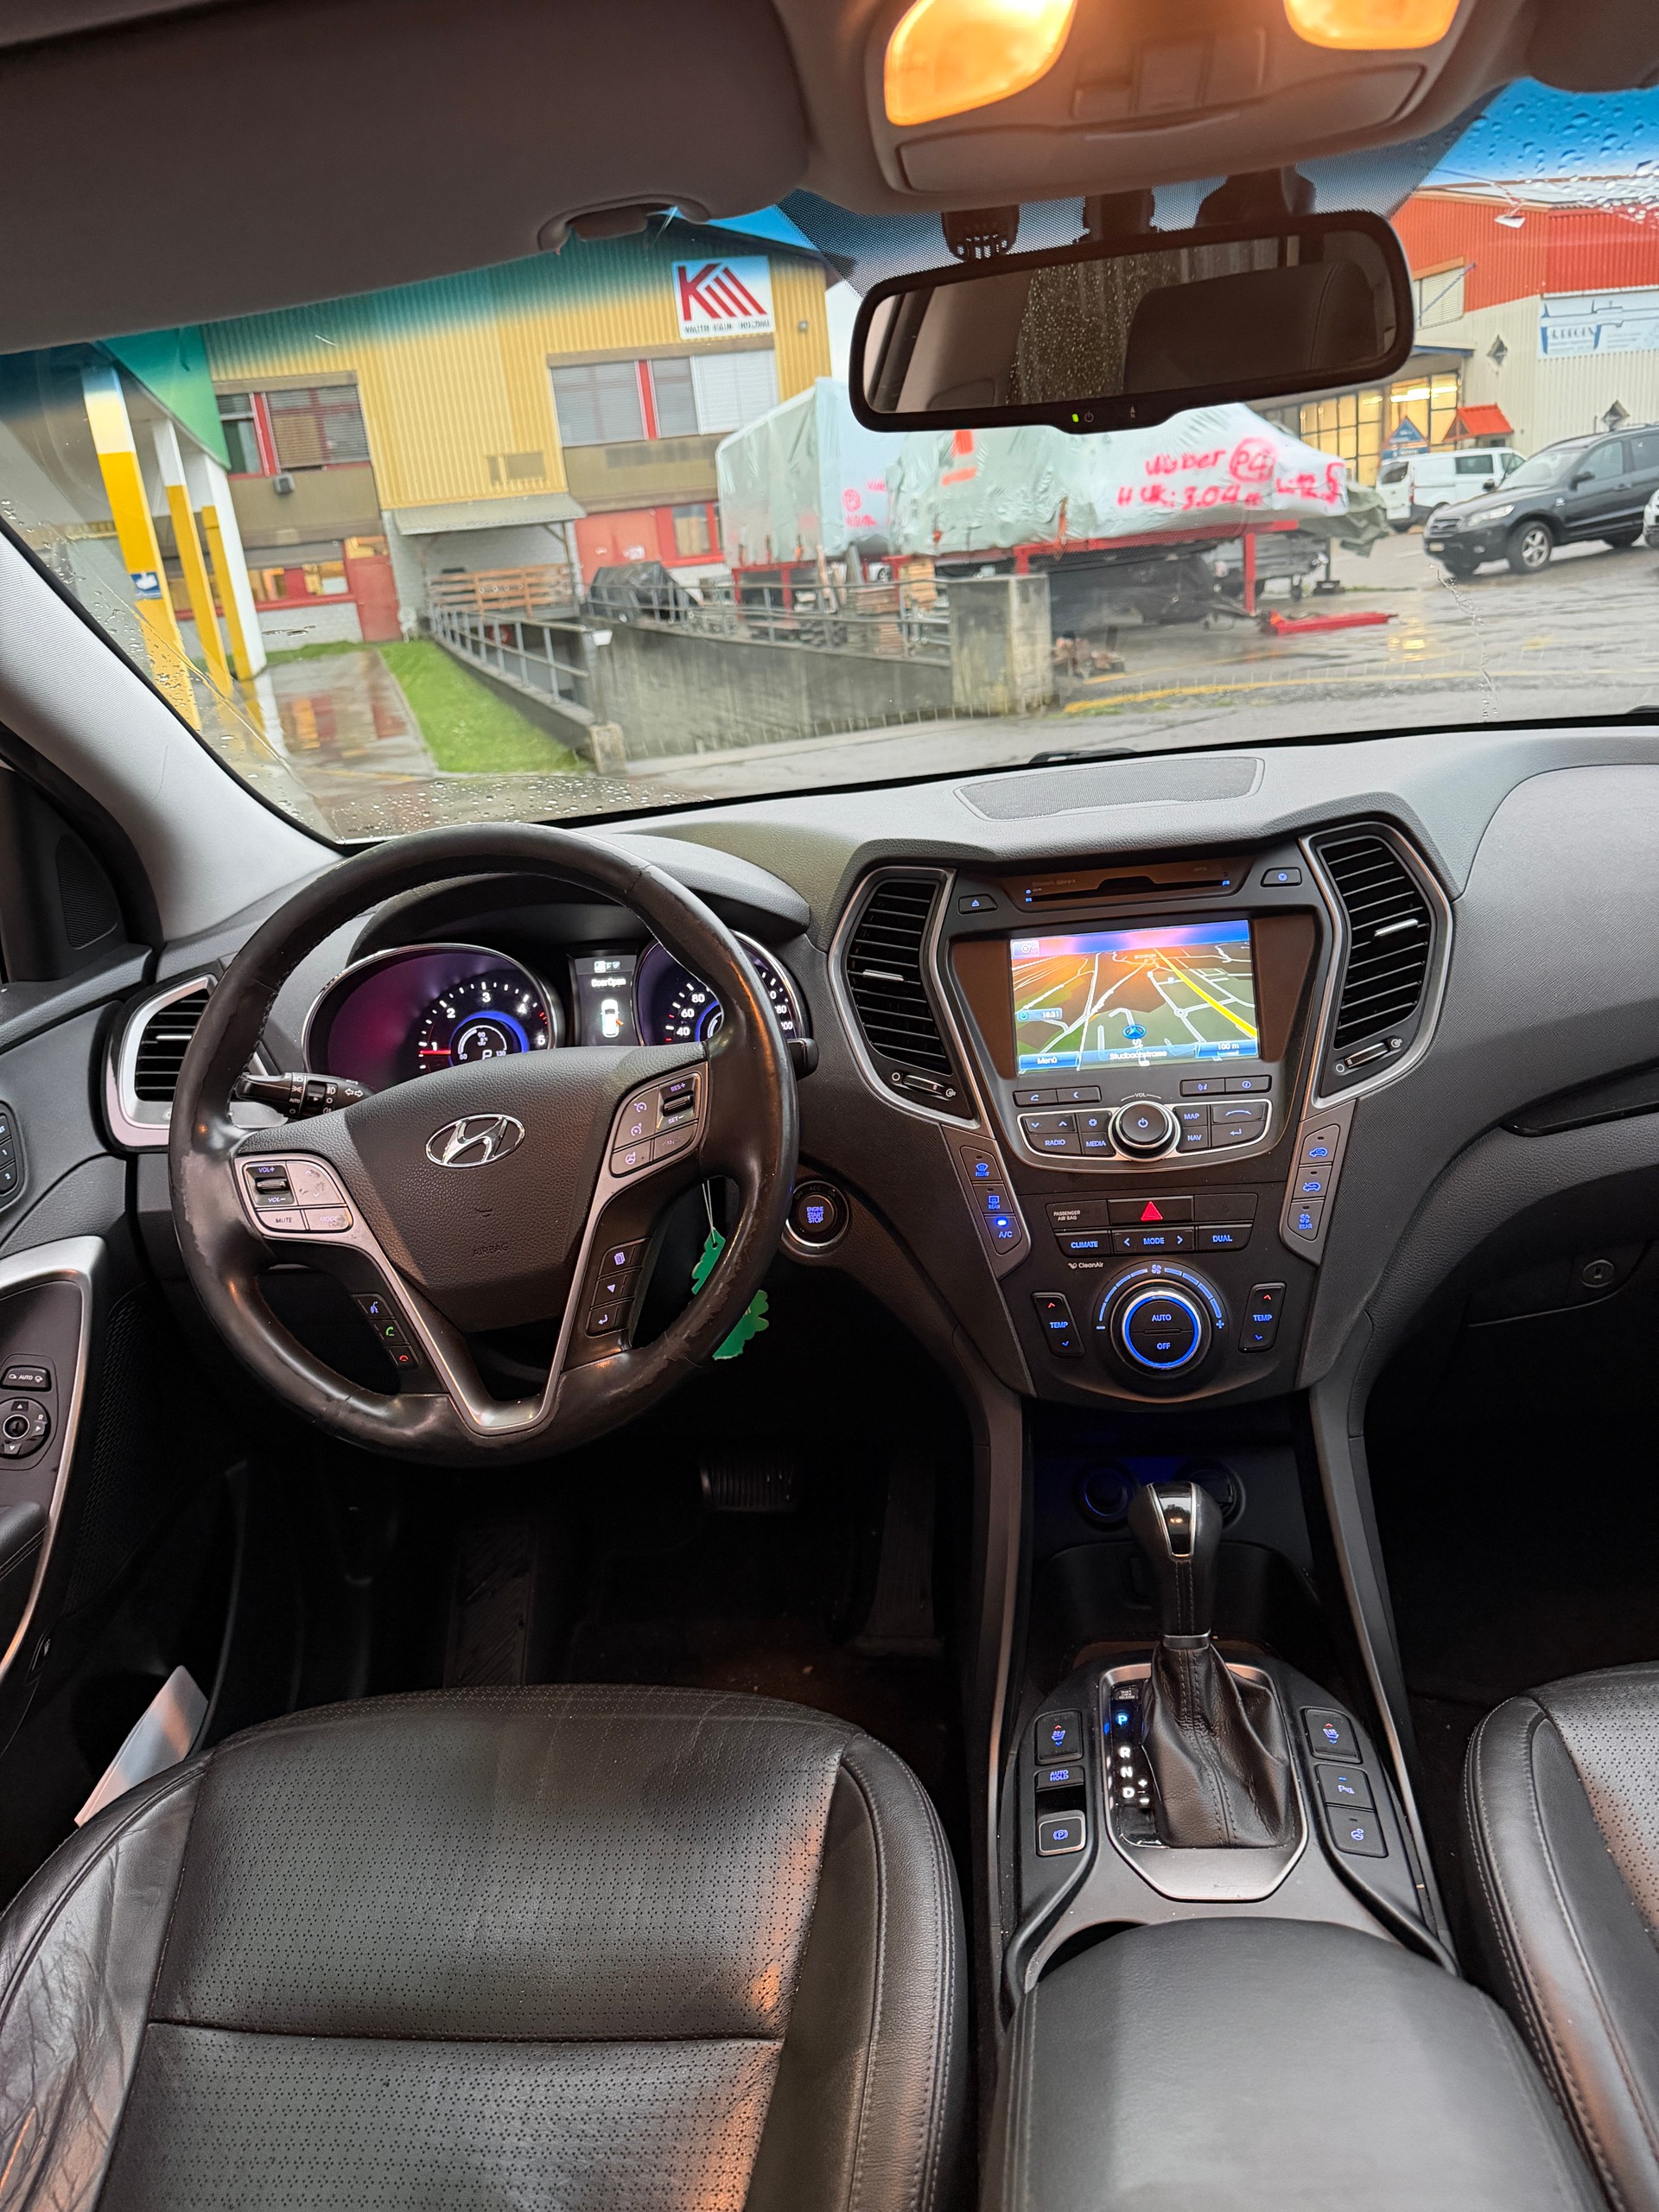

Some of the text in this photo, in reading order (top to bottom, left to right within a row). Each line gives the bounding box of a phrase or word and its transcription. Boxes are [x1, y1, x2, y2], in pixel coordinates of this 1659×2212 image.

[481, 992, 492, 1003] 3
[691, 994, 705, 1003] 80
[446, 1007, 456, 1019] 2
[518, 1003, 527, 1014] 4
[681, 1008, 695, 1018] 60
[676, 1027, 690, 1036] 40
[537, 1034, 545, 1046] 5
[1142, 1236, 1166, 1245] MODE
[1211, 1234, 1233, 1243] DUAL
[1151, 1313, 1172, 1322] AUTO
[1253, 1313, 1273, 1322] TEMP
[1116, 1713, 1128, 1726] P
[1119, 1746, 1131, 1758] R
[1120, 1766, 1133, 1778] N
[1122, 1787, 1135, 1799] D
